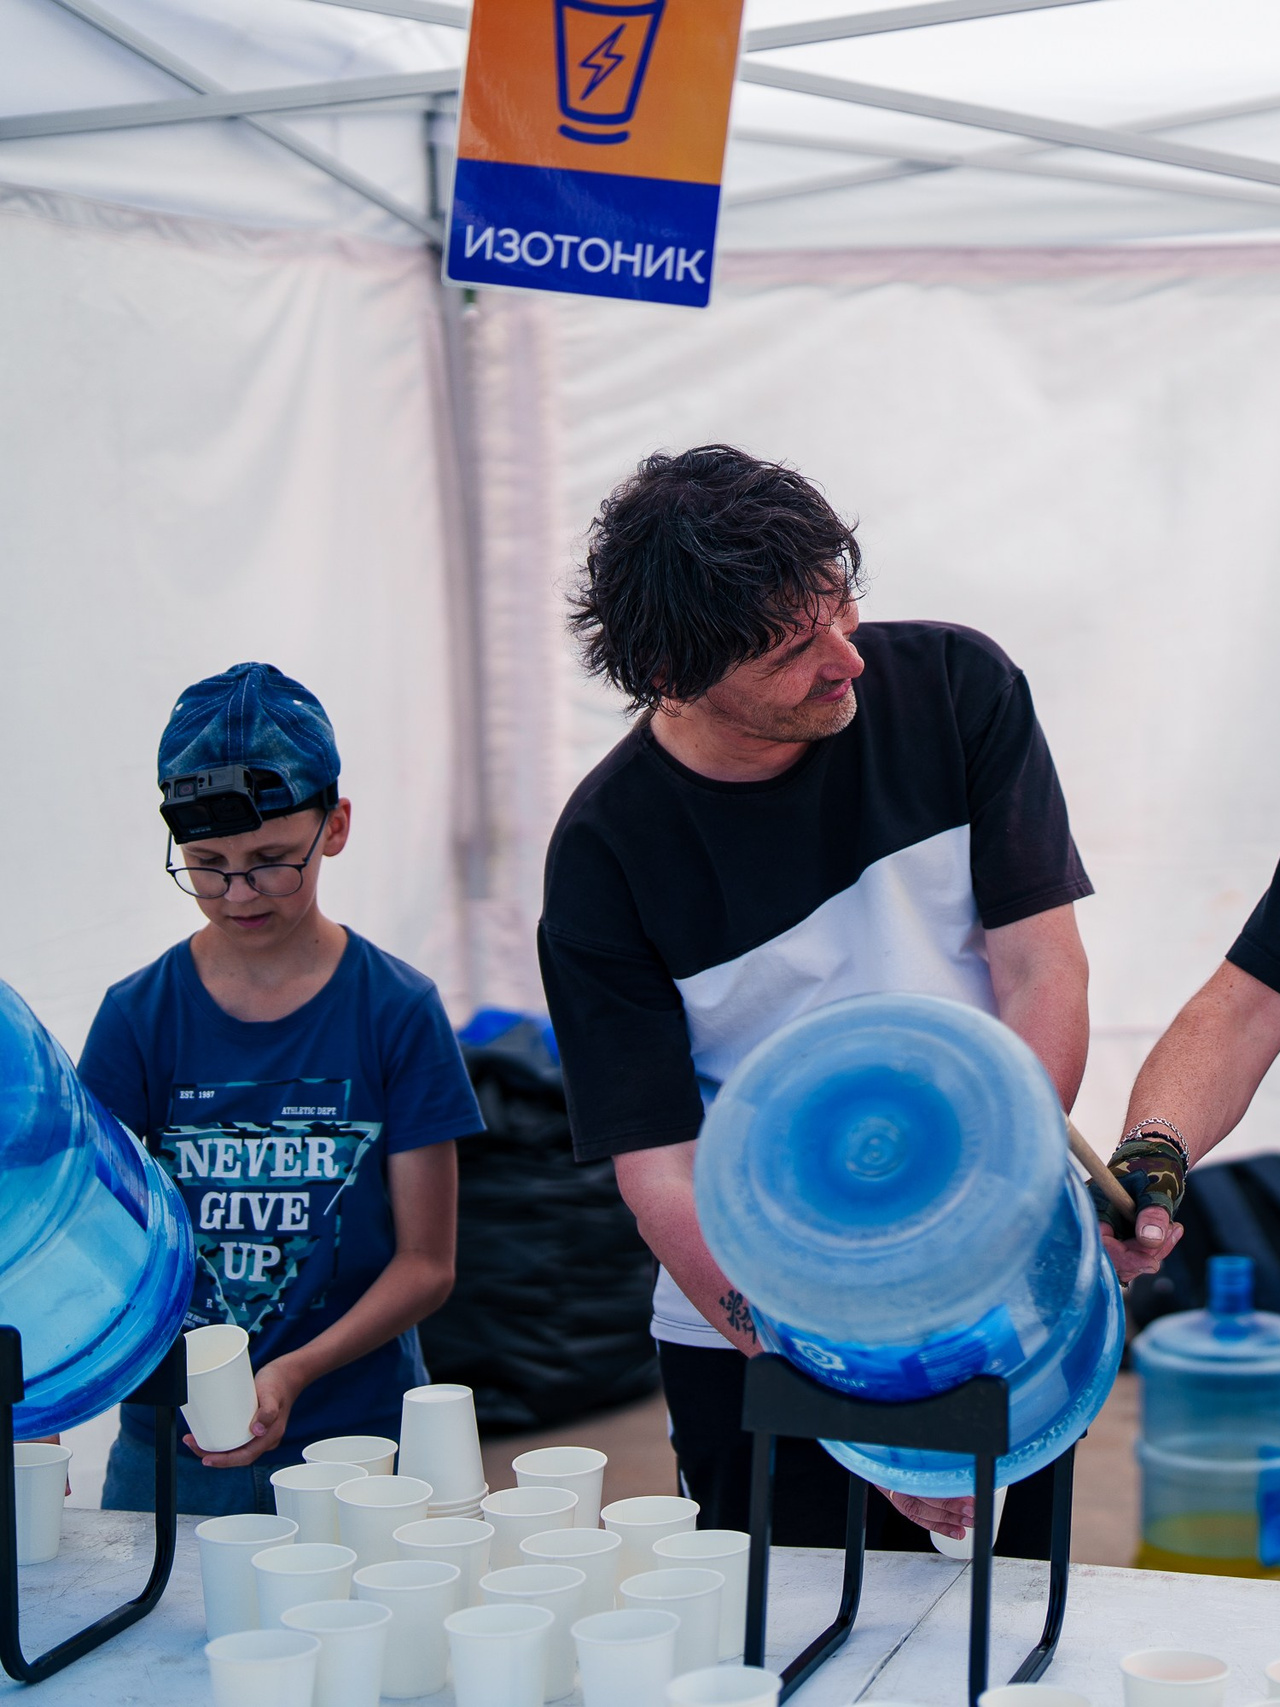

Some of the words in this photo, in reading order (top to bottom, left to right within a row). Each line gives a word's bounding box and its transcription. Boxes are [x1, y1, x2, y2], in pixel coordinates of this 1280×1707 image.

[464, 224, 706, 284] ИЗОТОНИК
[281, 1106, 316, 1115] ATHLETIC
[175, 1137, 339, 1179] NEVER
[199, 1192, 310, 1231] GIVE
[220, 1242, 281, 1282] UP
